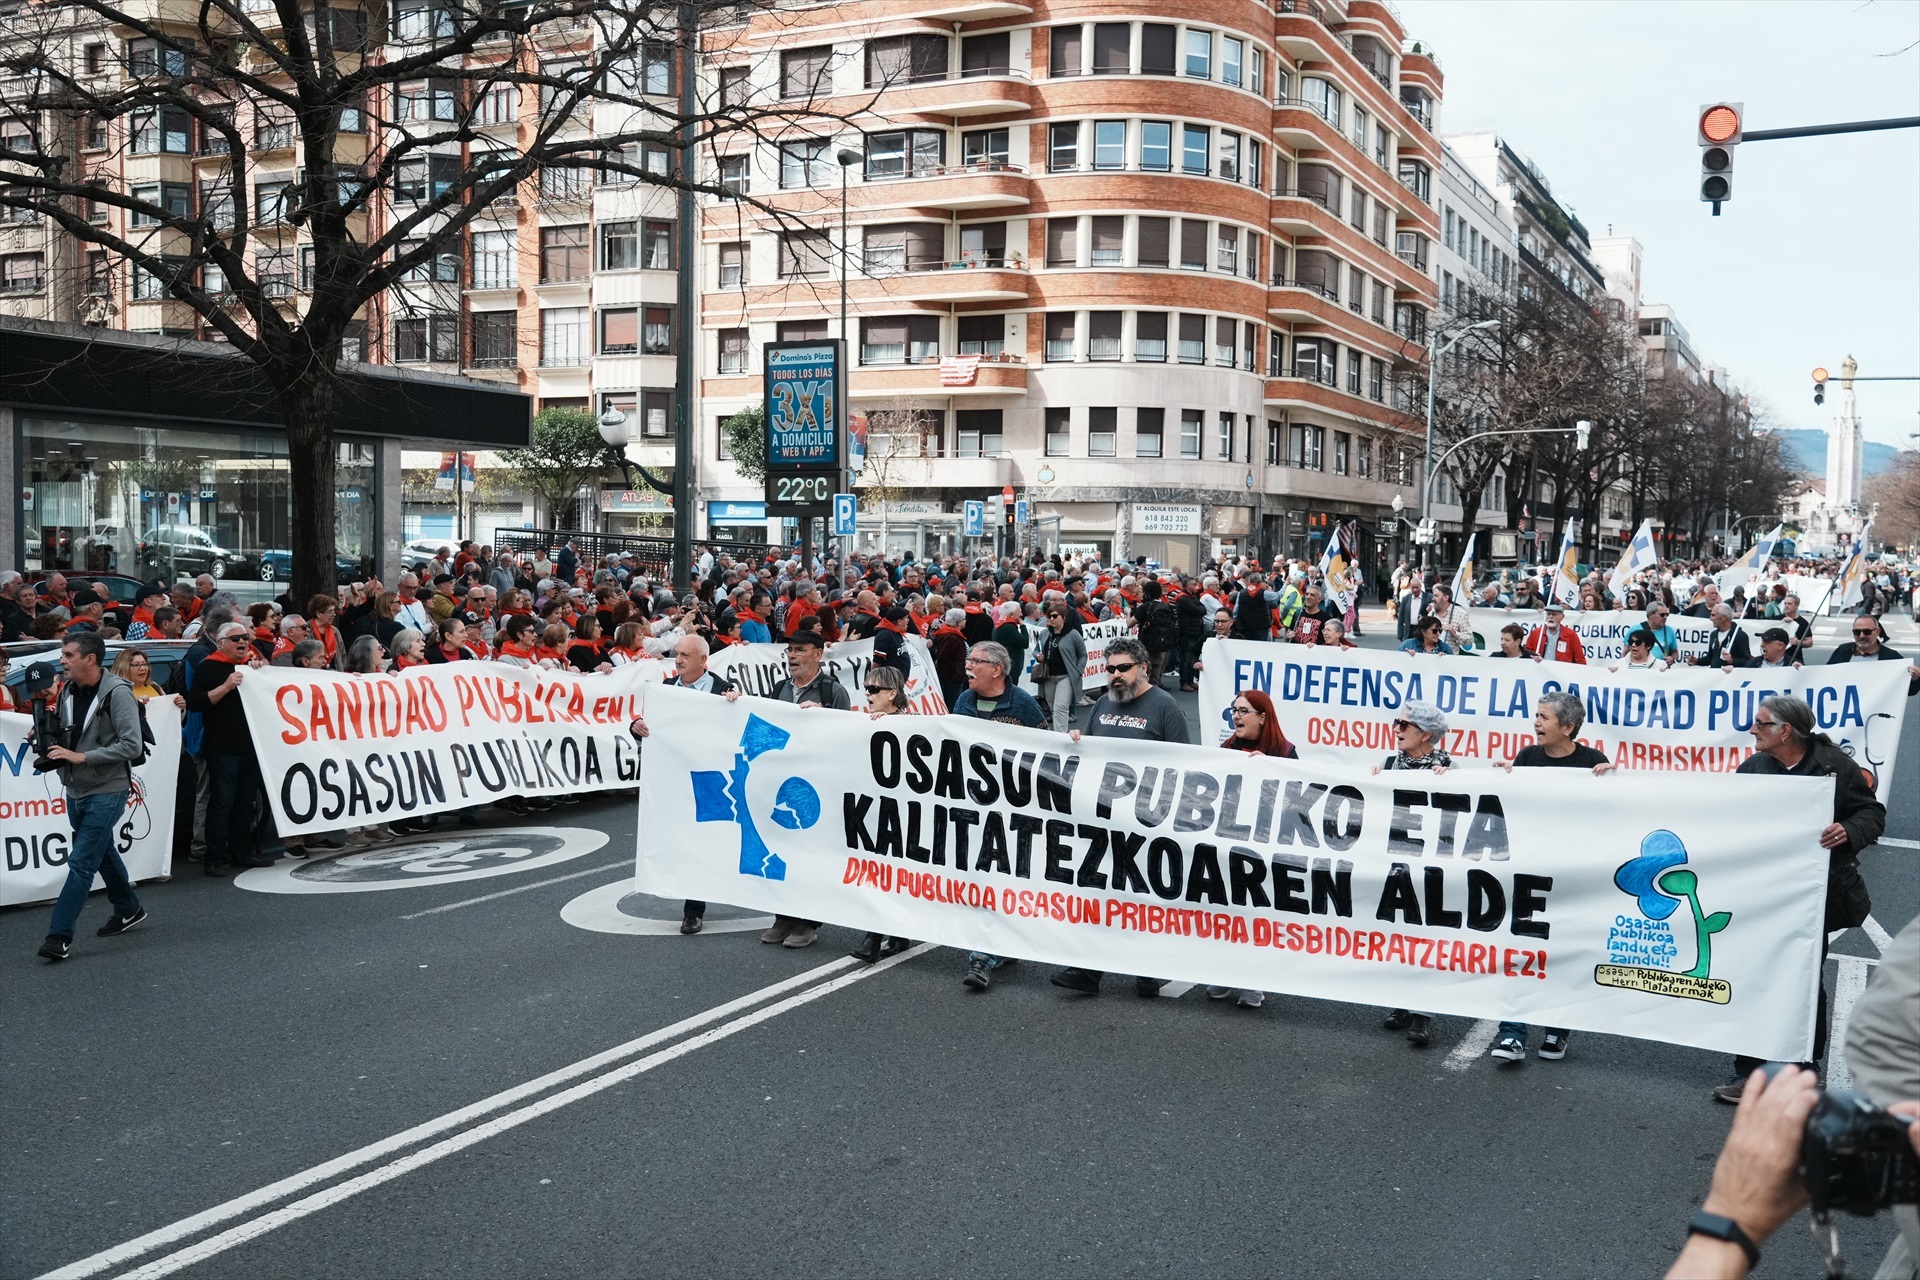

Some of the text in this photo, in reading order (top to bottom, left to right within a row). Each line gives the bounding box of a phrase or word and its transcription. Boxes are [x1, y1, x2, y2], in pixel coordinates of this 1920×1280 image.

[780, 352, 833, 362] Domino's Pizza
[772, 366, 833, 380] TODOS LOS DÍAS
[771, 380, 834, 432] 3X1
[772, 432, 833, 446] A DOMICILIO
[782, 445, 825, 457] WEB Y APP
[777, 477, 828, 501] 22°C
[621, 492, 654, 503] ATLAS
[1175, 515, 1189, 523] 320
[1597, 645, 1612, 658] LA
[1234, 659, 1864, 733] EN DEFENSA DE LA NIDAD PÚICA
[275, 675, 448, 746] SANIDAD
[593, 695, 625, 724] EN
[280, 747, 446, 826] OSASUN
[870, 731, 1513, 863] OSASUN PUBLIKO ETA
[842, 792, 1554, 940] KALITATEZKOAREN ALDE
[842, 857, 1549, 980] DIRU PUBLIKOA OSASUN PRIBATURA DESBIDERATZEARI EZ!
[1615, 915, 1670, 931] Osasun
[1610, 927, 1674, 943] publikoa
[1606, 938, 1677, 957] landu eta
[1609, 953, 1671, 968] zaindu!!
[1598, 966, 1635, 977] Osasun
[1612, 977, 1714, 1000] Herri Plataformak
